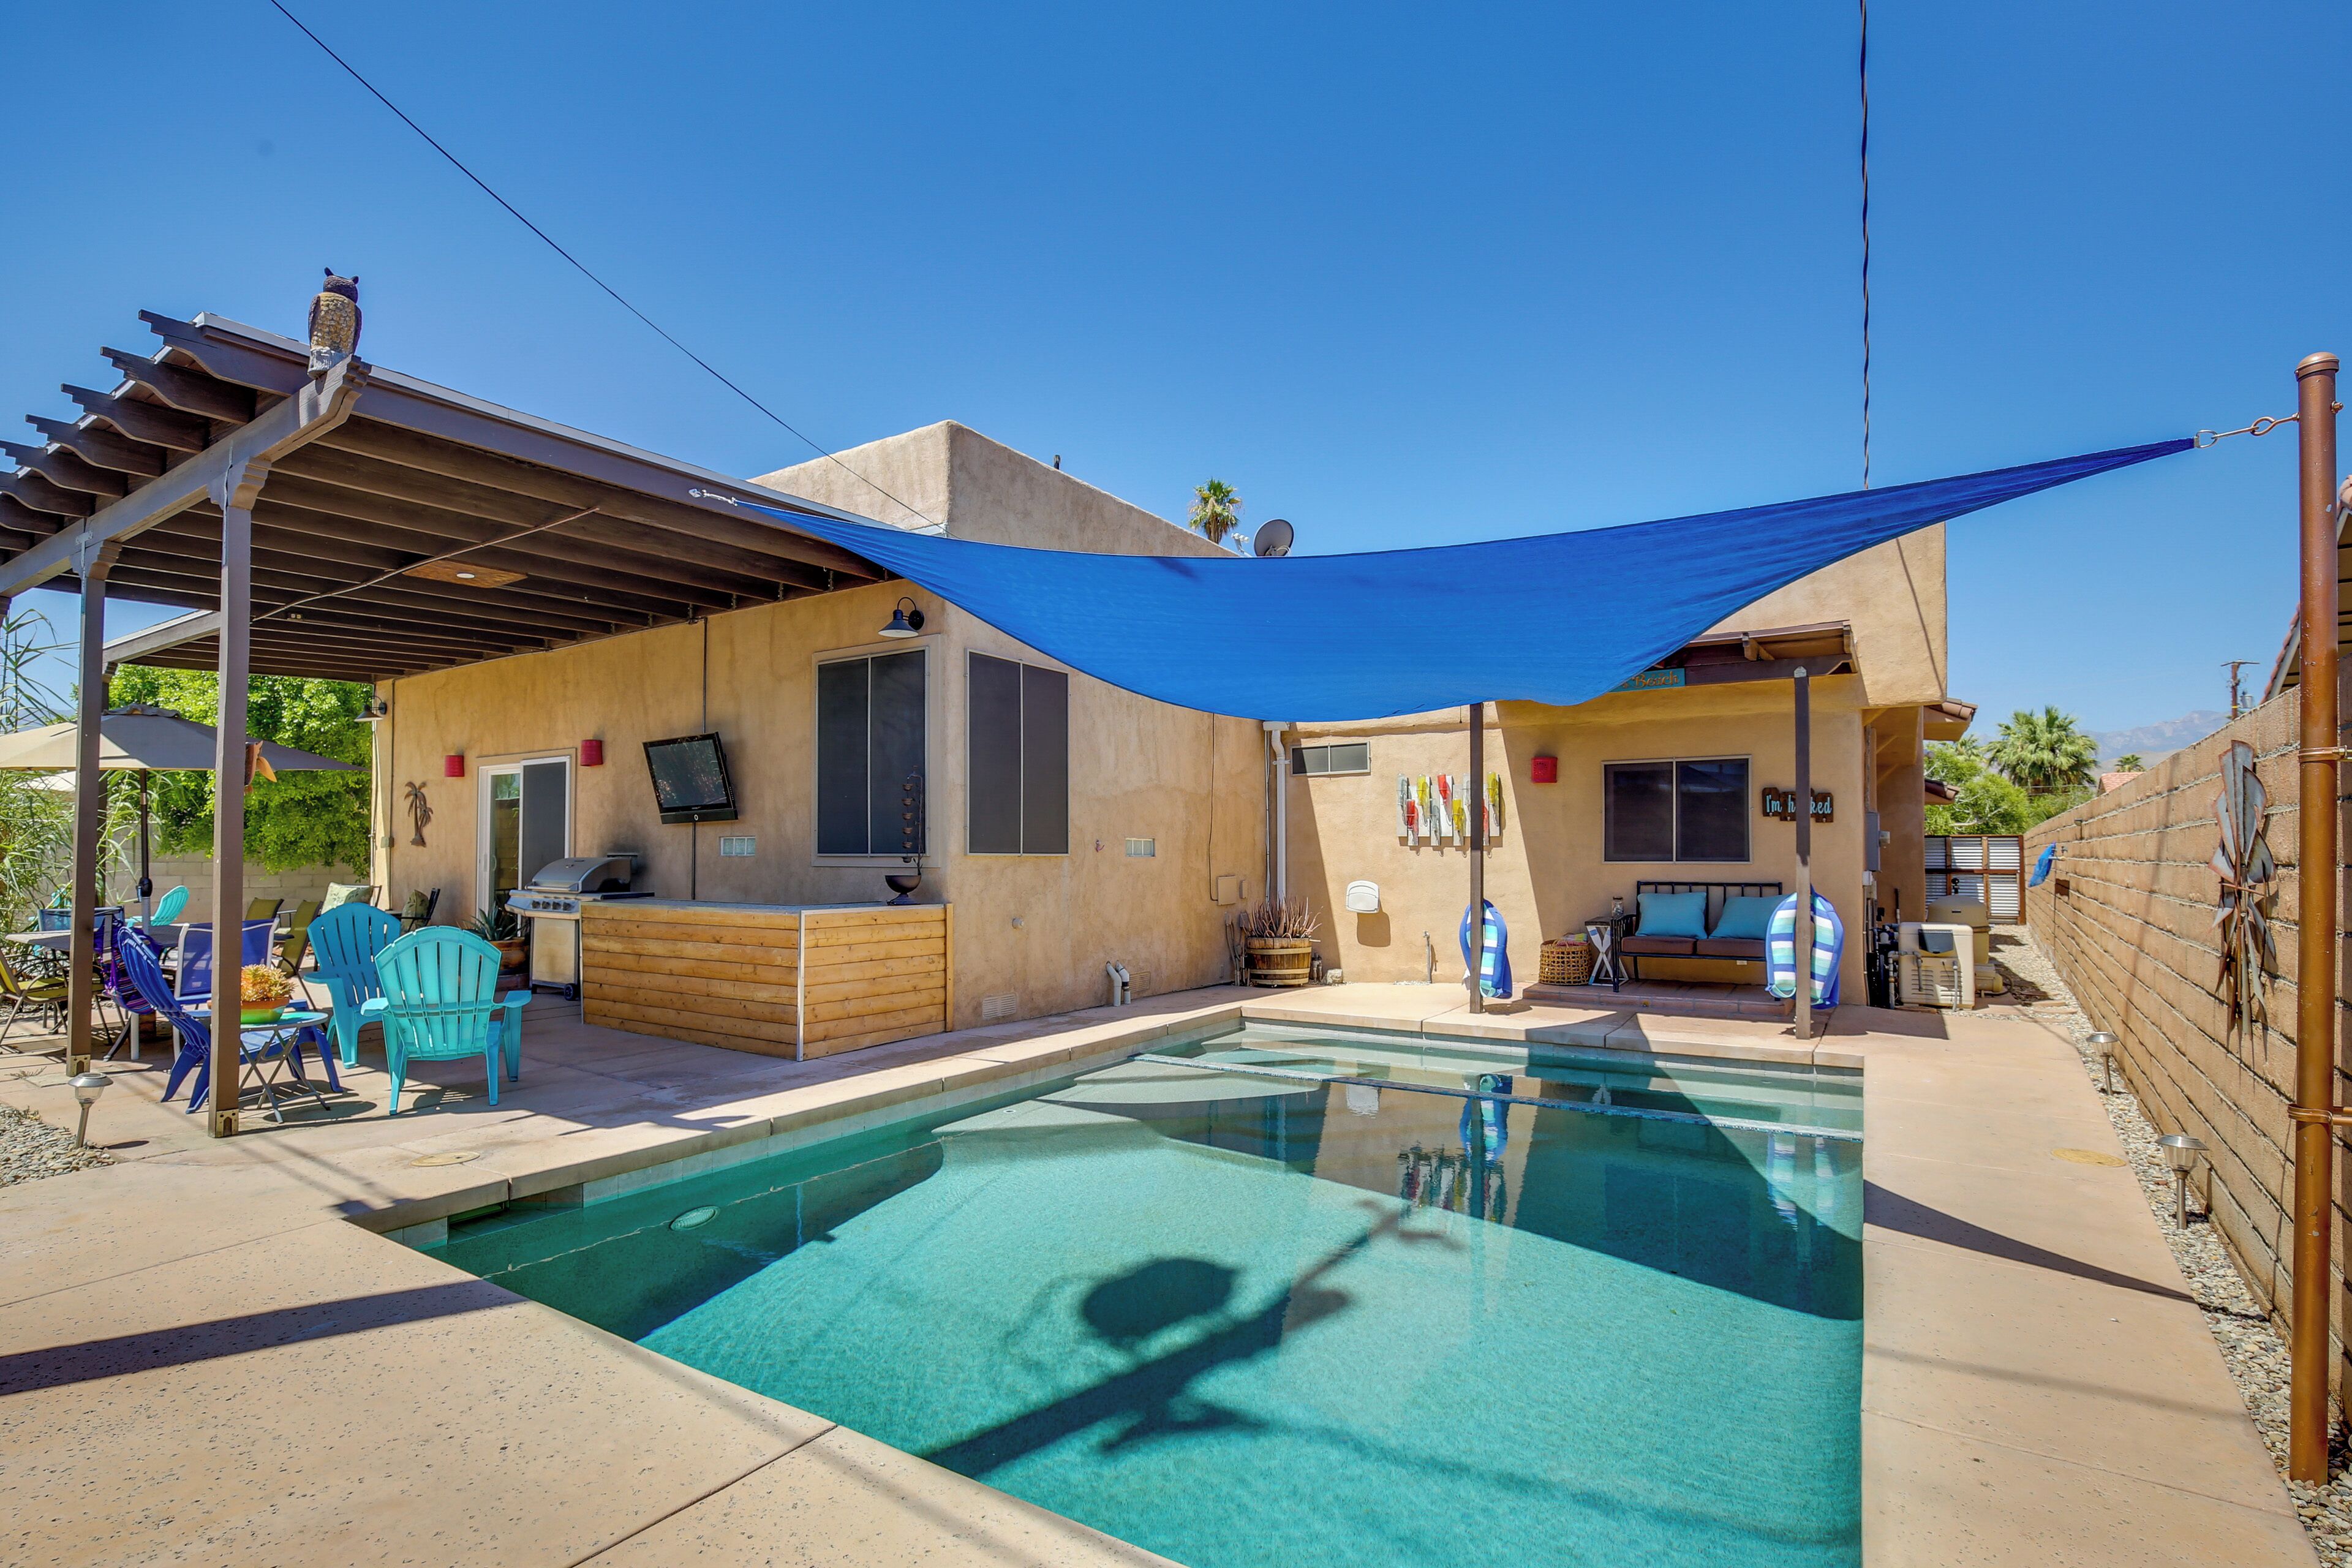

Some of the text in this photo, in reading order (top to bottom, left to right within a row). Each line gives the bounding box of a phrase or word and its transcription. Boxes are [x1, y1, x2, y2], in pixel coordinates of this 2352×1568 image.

[1632, 671, 1679, 688] Beach
[1766, 794, 1832, 814] I'm hked
